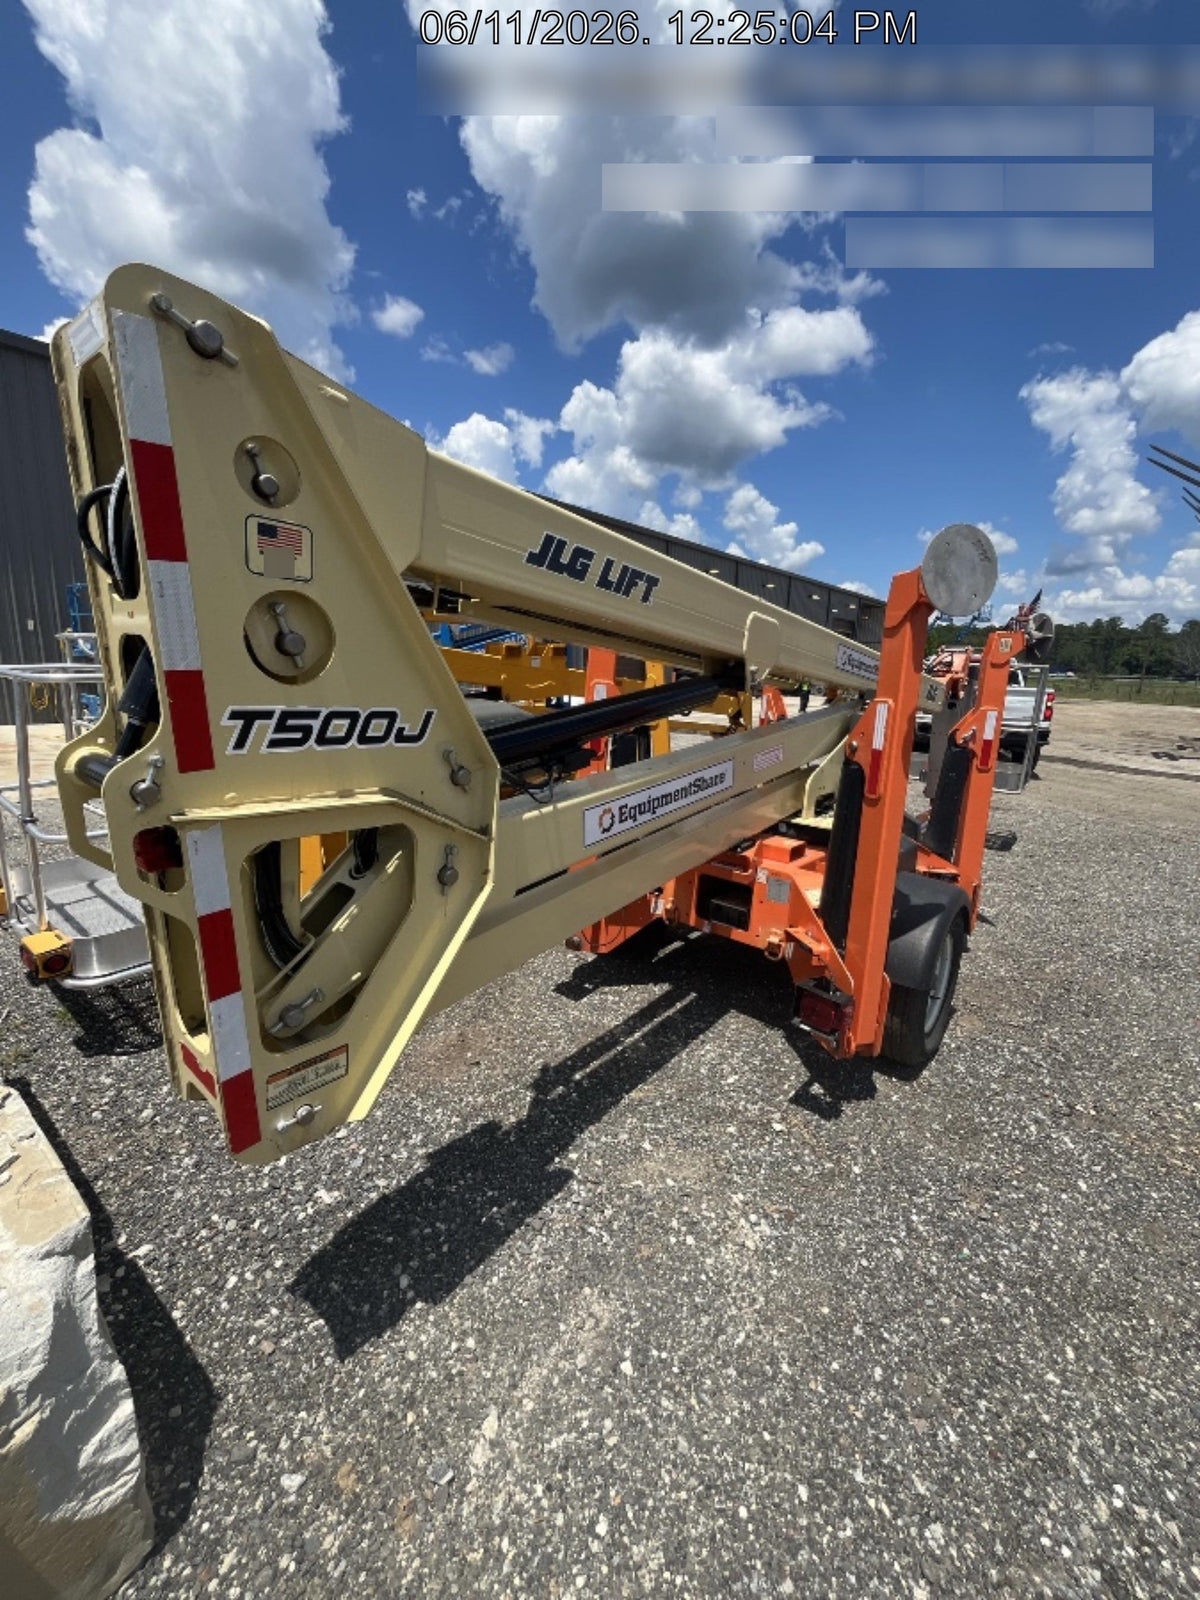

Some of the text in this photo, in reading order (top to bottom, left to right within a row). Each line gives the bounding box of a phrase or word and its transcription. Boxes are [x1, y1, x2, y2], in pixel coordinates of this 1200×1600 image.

[524, 531, 661, 605] JLG LIFT
[221, 705, 437, 754] T500J
[618, 770, 727, 824] EquipmentShare
